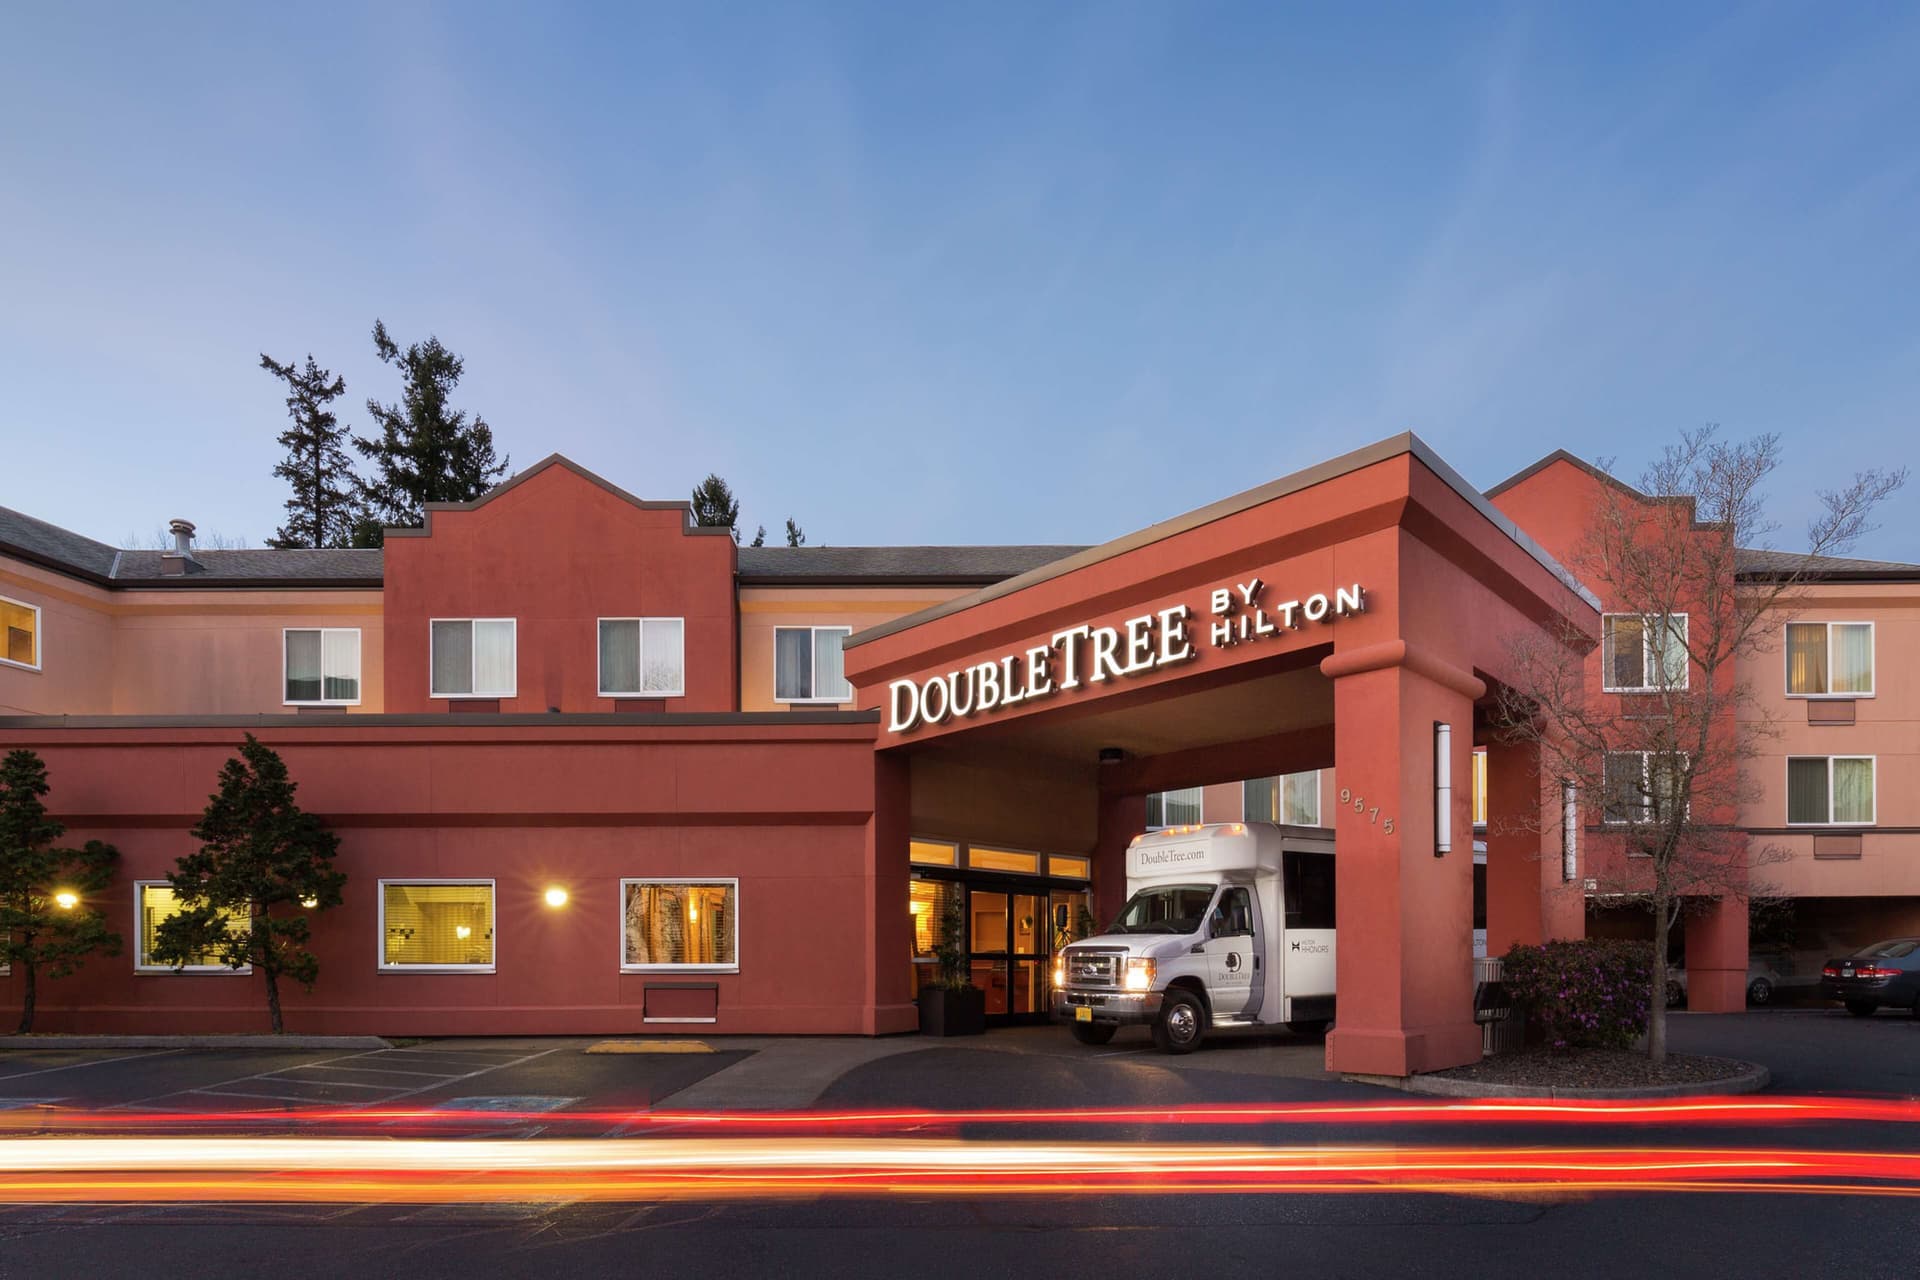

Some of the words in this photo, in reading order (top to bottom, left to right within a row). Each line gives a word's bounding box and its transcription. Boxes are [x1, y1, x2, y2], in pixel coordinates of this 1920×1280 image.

[1211, 578, 1259, 614] BY
[1211, 583, 1361, 646] HILTON
[1340, 788, 1395, 835] 9575
[1140, 849, 1205, 865] DoubleTree.com
